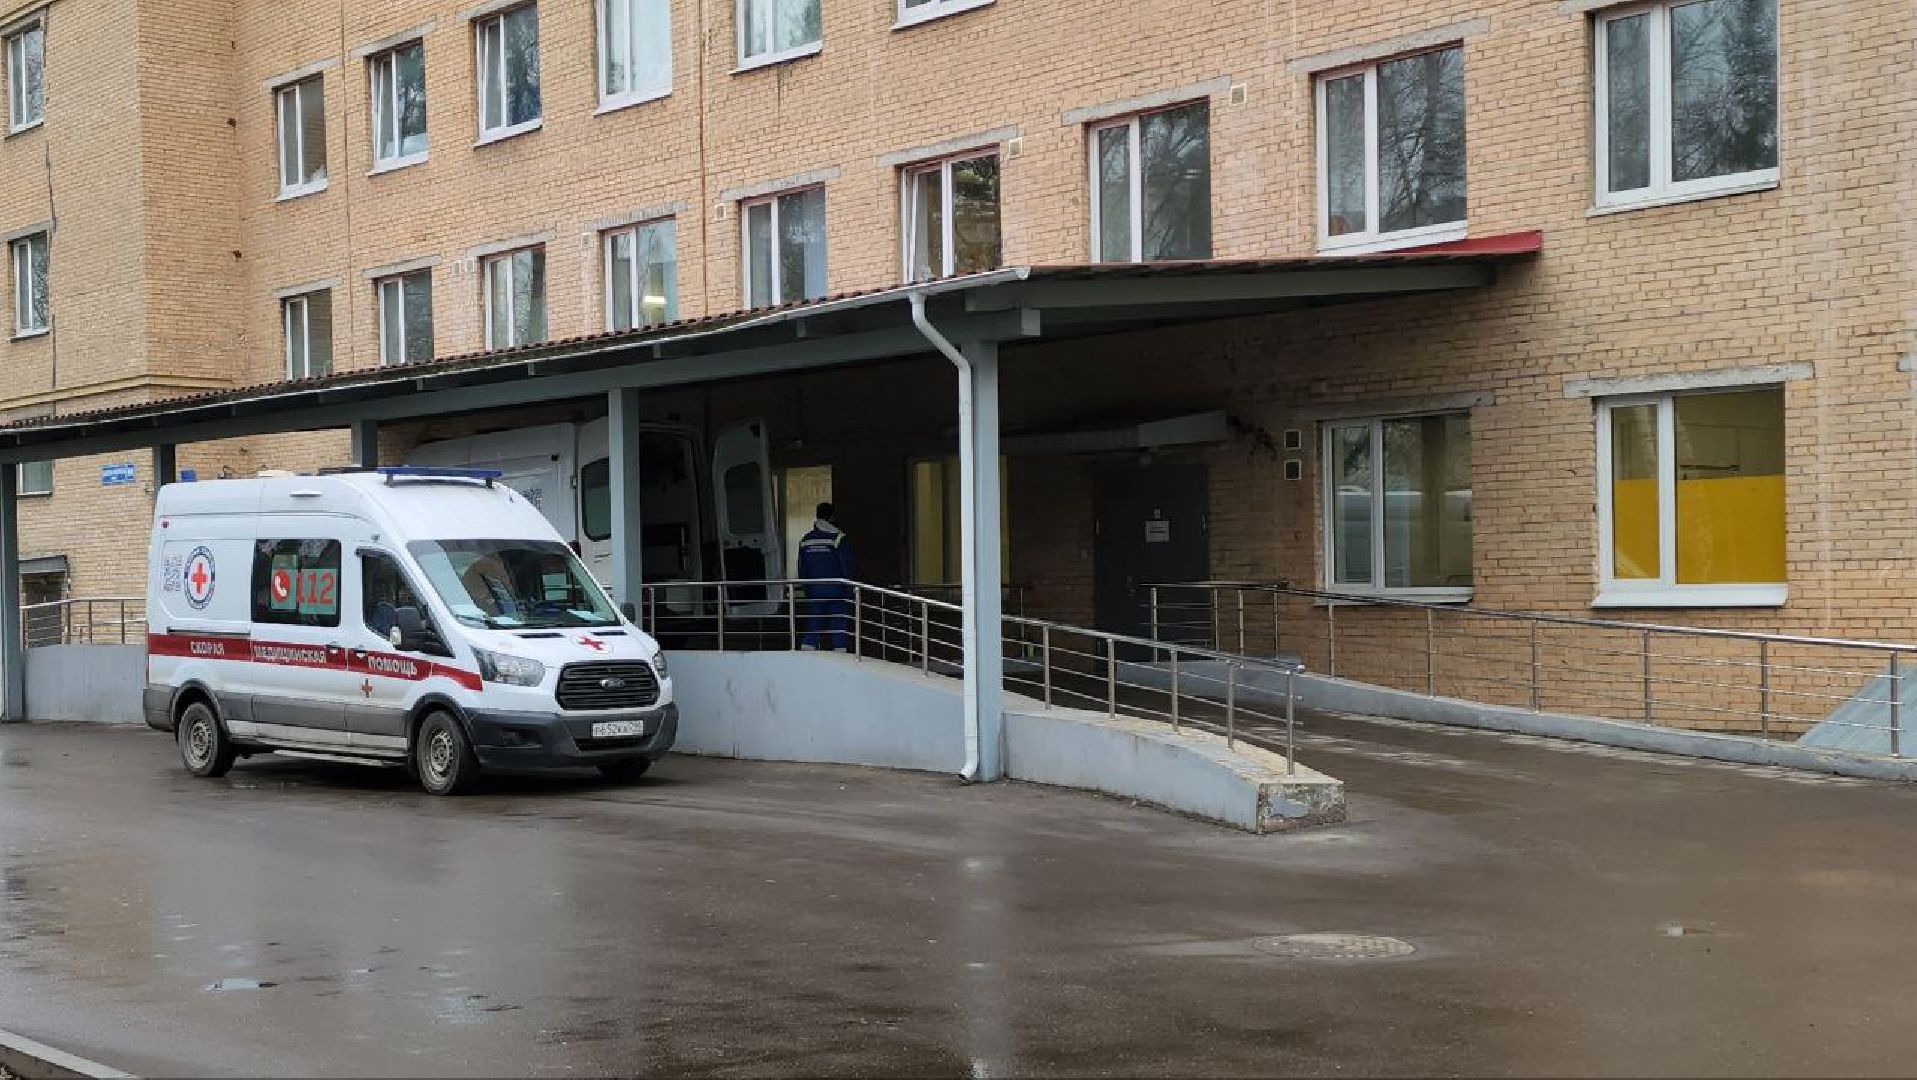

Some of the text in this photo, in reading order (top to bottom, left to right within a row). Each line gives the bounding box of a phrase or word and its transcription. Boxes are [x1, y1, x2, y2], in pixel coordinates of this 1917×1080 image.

[295, 571, 336, 605] 112
[190, 641, 418, 677] СКОРАЯ МЕДИЦИНСКАЯ ПОМОЩЬ
